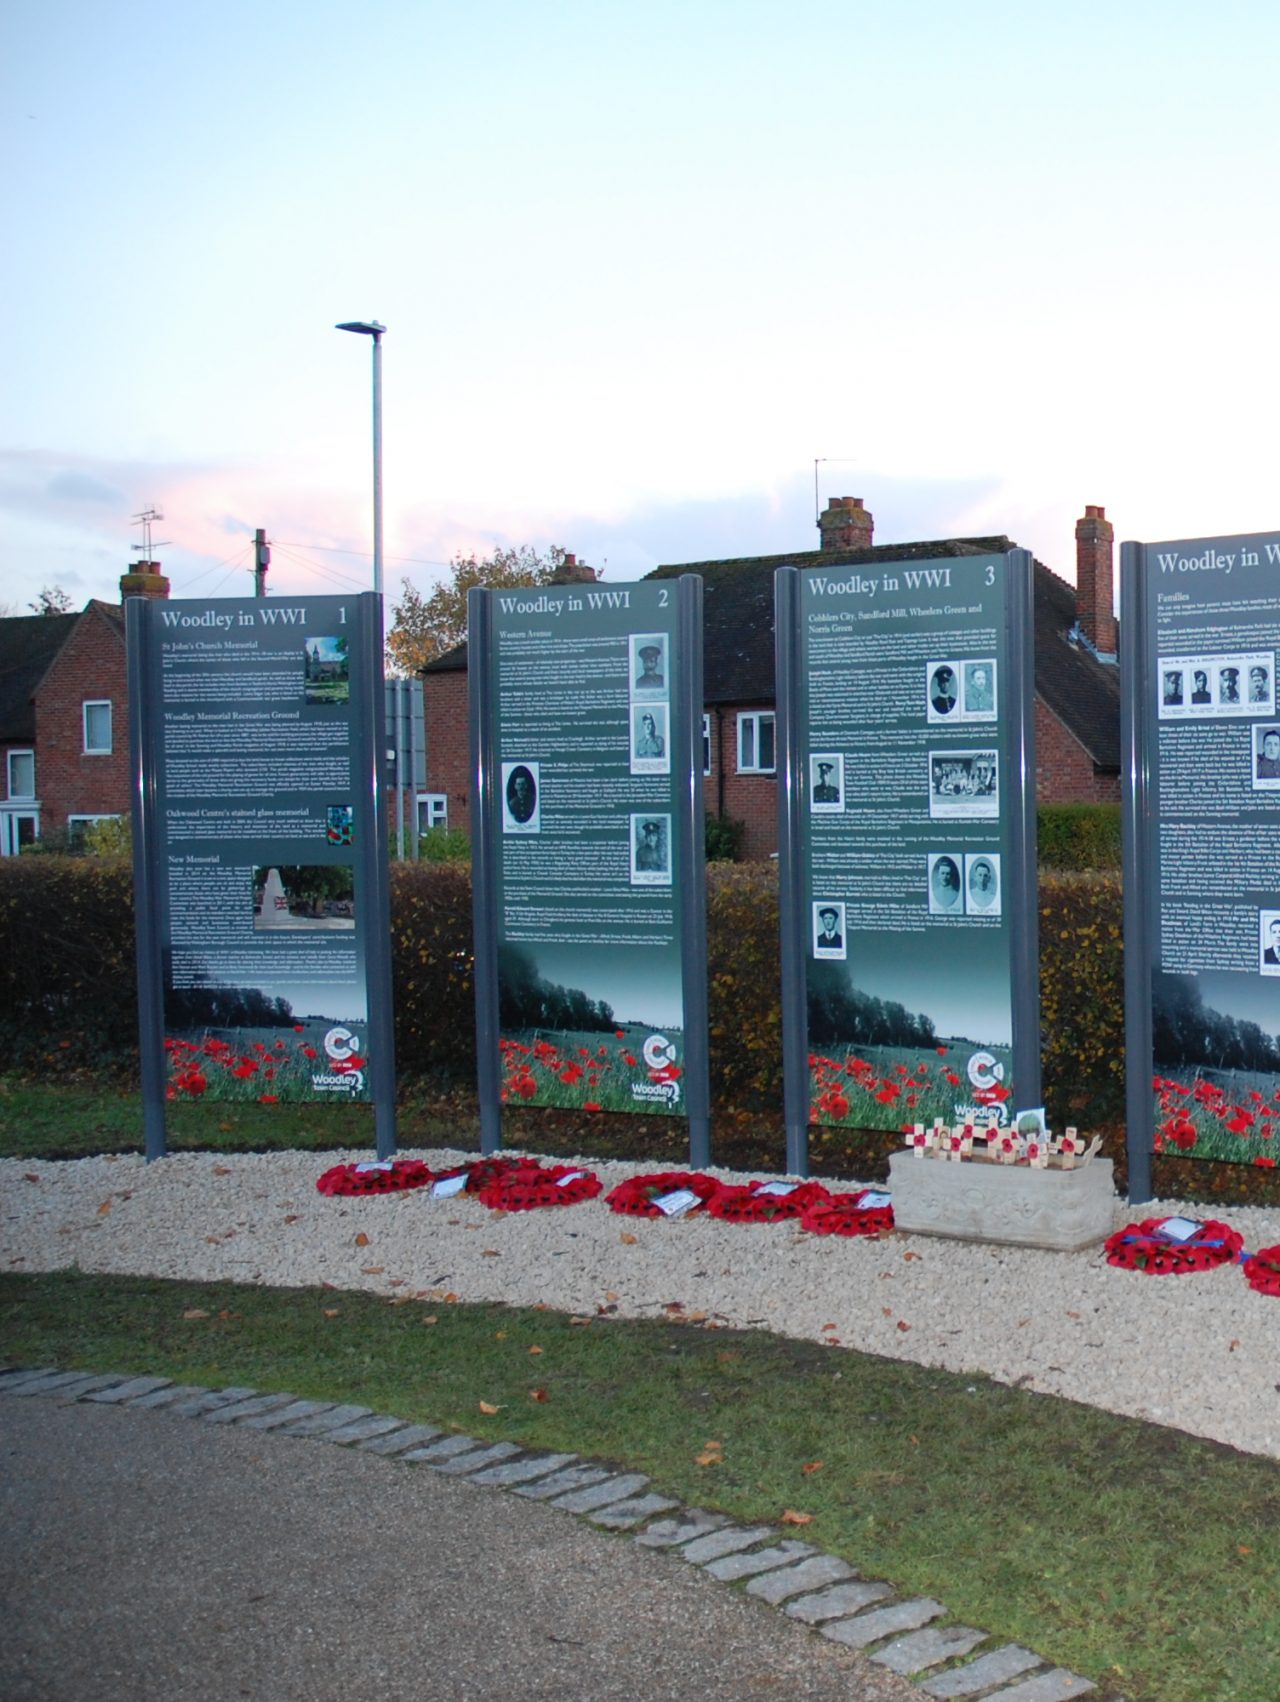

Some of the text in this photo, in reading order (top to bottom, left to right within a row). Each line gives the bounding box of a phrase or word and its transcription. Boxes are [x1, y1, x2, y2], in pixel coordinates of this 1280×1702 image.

[1157, 549, 1236, 573] Woodley
[1241, 547, 1259, 566] in
[808, 565, 995, 596] Woodley in WWI 3
[499, 589, 668, 616] Woodley in WWI 2
[161, 606, 346, 630] Woodley in WWI 1
[168, 855, 220, 863] New Memorial
[312, 1074, 357, 1086] Woodley
[632, 1083, 673, 1098] Woodley
